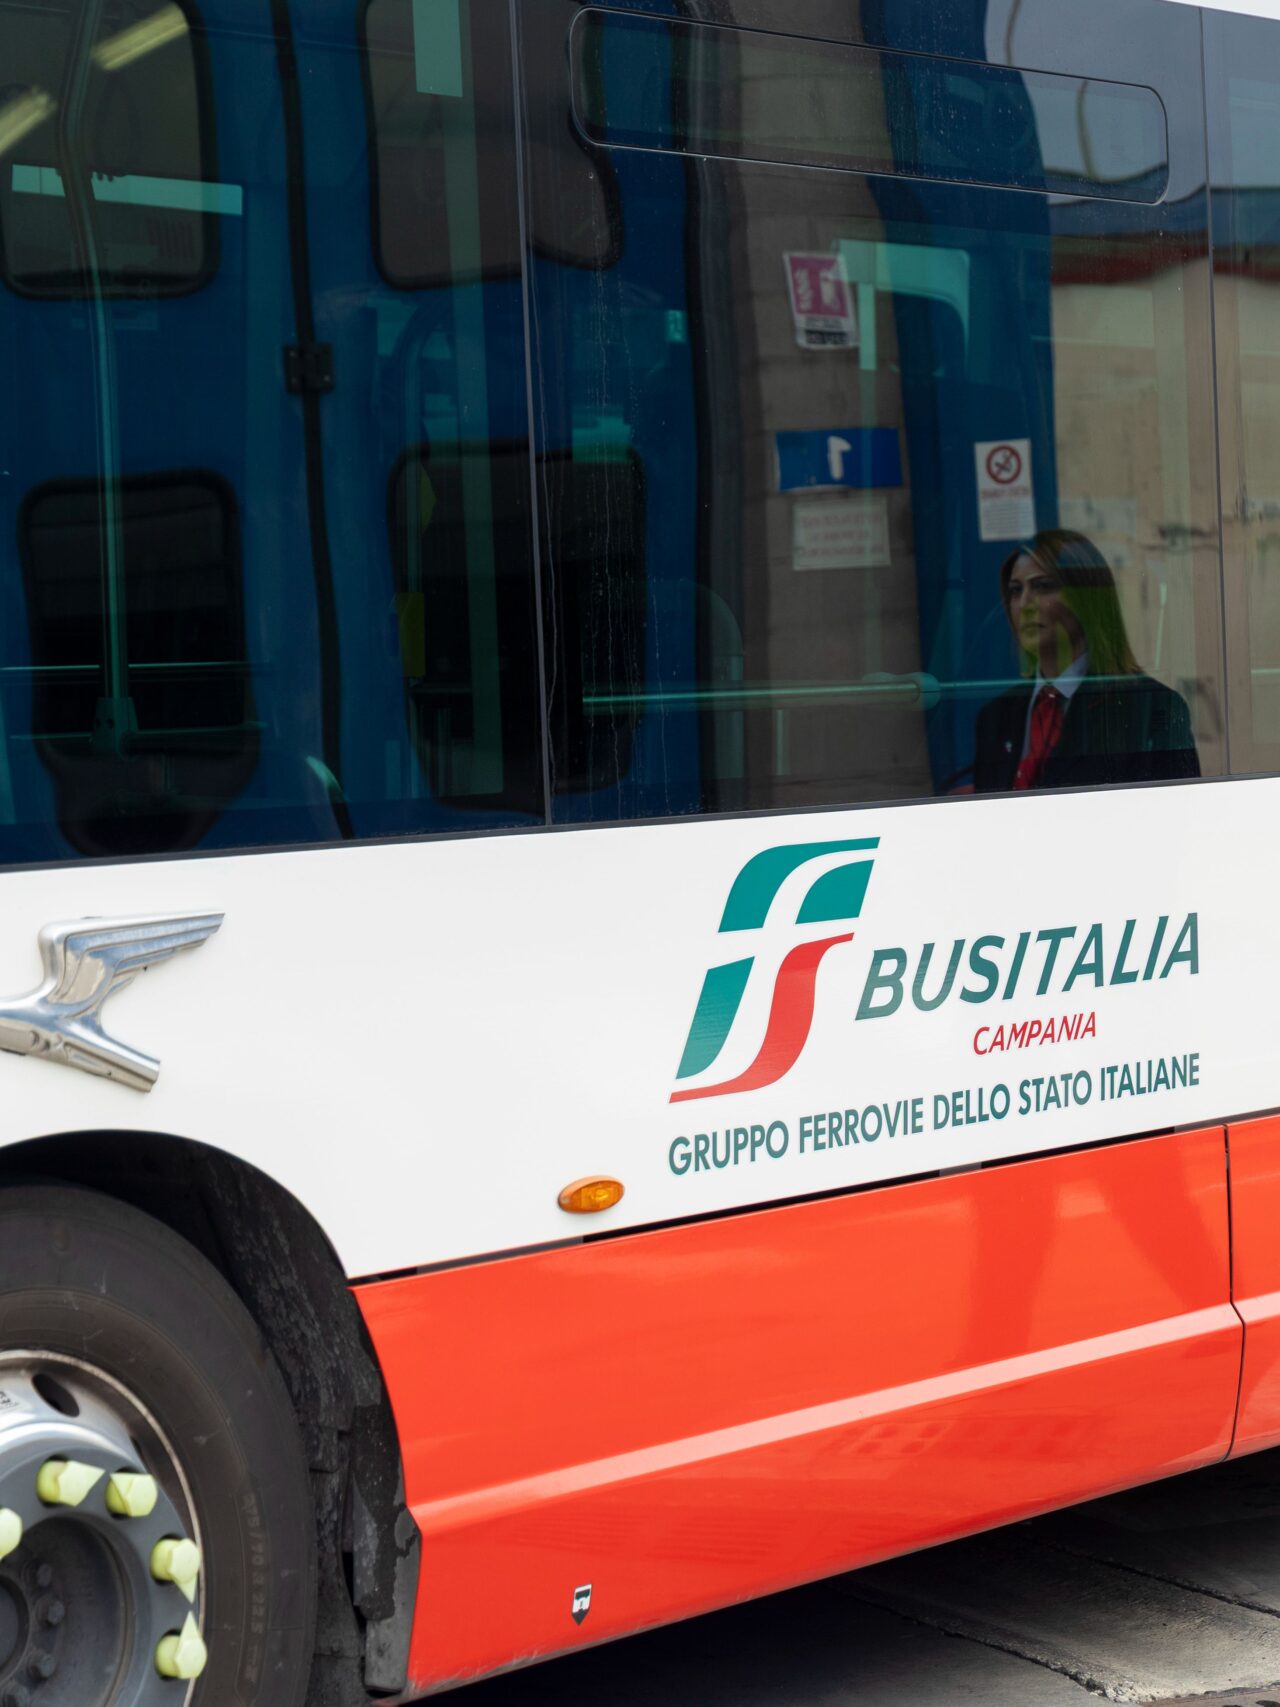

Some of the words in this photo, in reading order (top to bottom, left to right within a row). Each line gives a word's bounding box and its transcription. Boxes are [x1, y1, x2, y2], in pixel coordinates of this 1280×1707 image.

[854, 912, 1200, 1021] BUSITALIA
[973, 1011, 1096, 1055] CAMPANIA
[668, 1120, 790, 1176] GRUPPO
[799, 1097, 924, 1153] FERROVIE
[933, 1083, 1011, 1130] DELLO
[1018, 1070, 1093, 1116] STATO
[1100, 1053, 1200, 1103] ITALIANE
